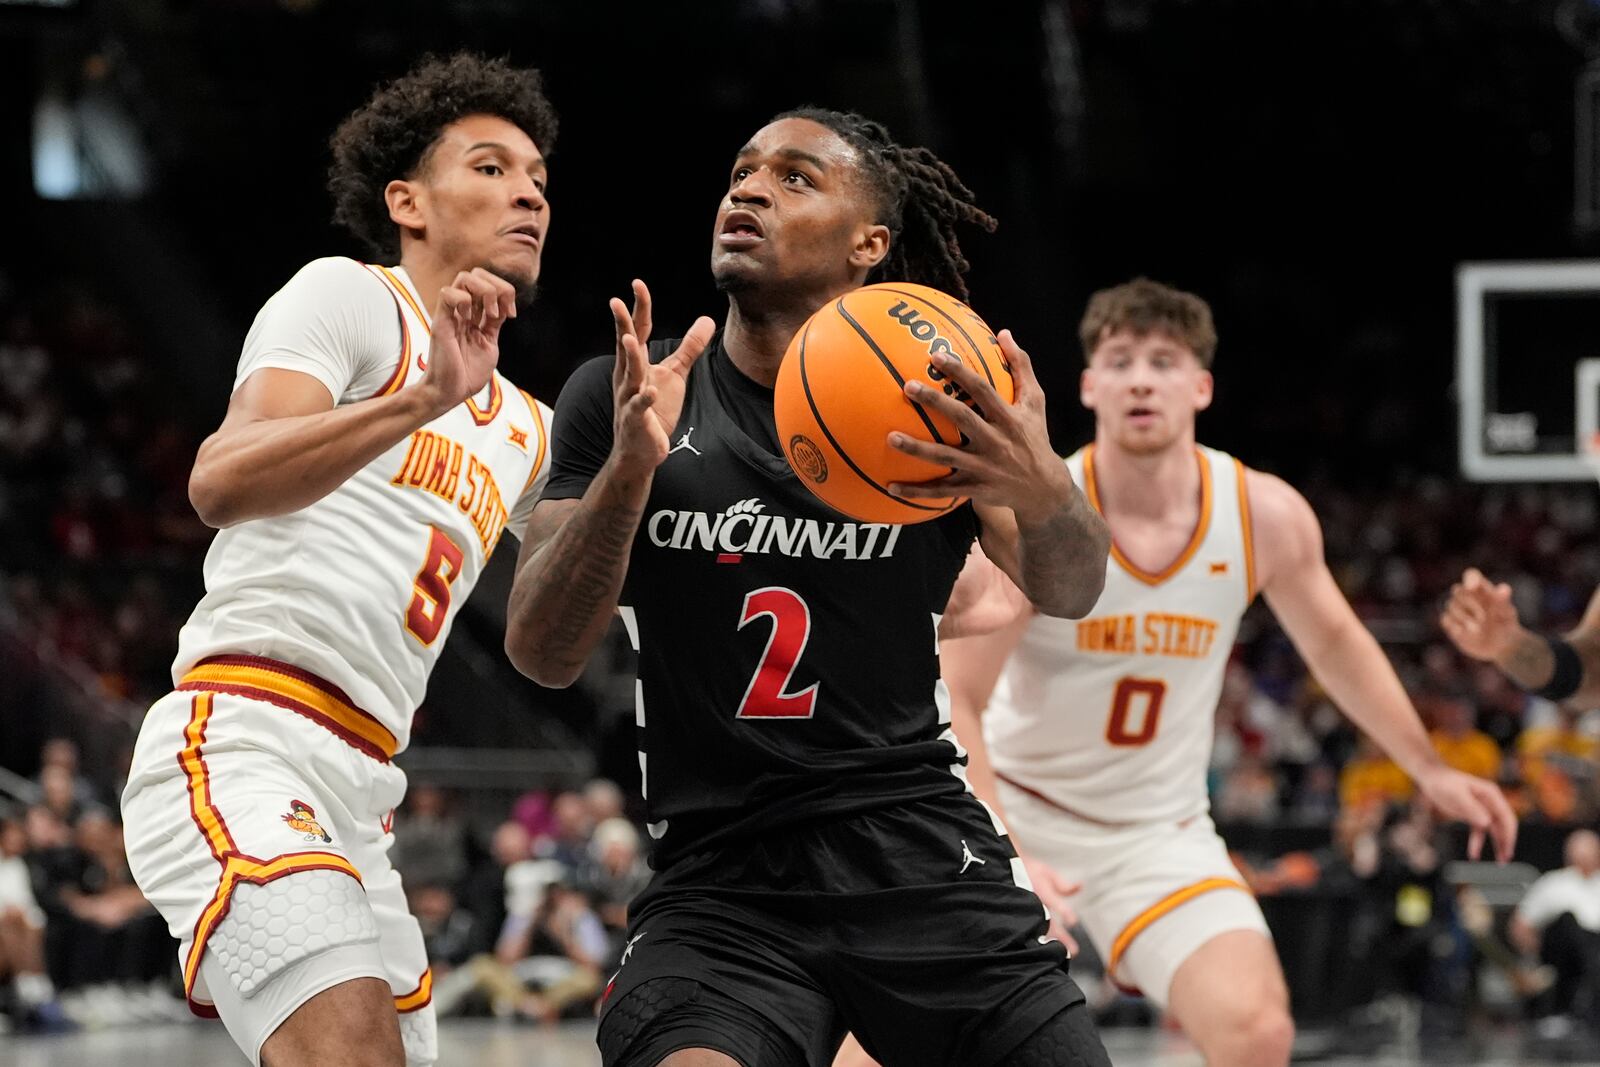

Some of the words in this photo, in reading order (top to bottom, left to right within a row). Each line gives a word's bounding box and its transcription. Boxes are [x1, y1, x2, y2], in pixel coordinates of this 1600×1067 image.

[391, 429, 464, 503] IOWA
[648, 503, 903, 561] CINCINNATI
[403, 524, 464, 648] 5
[735, 586, 821, 719] 2
[1077, 614, 1136, 656] IOWA
[1143, 611, 1219, 660] STATE
[1106, 674, 1167, 748] 0
